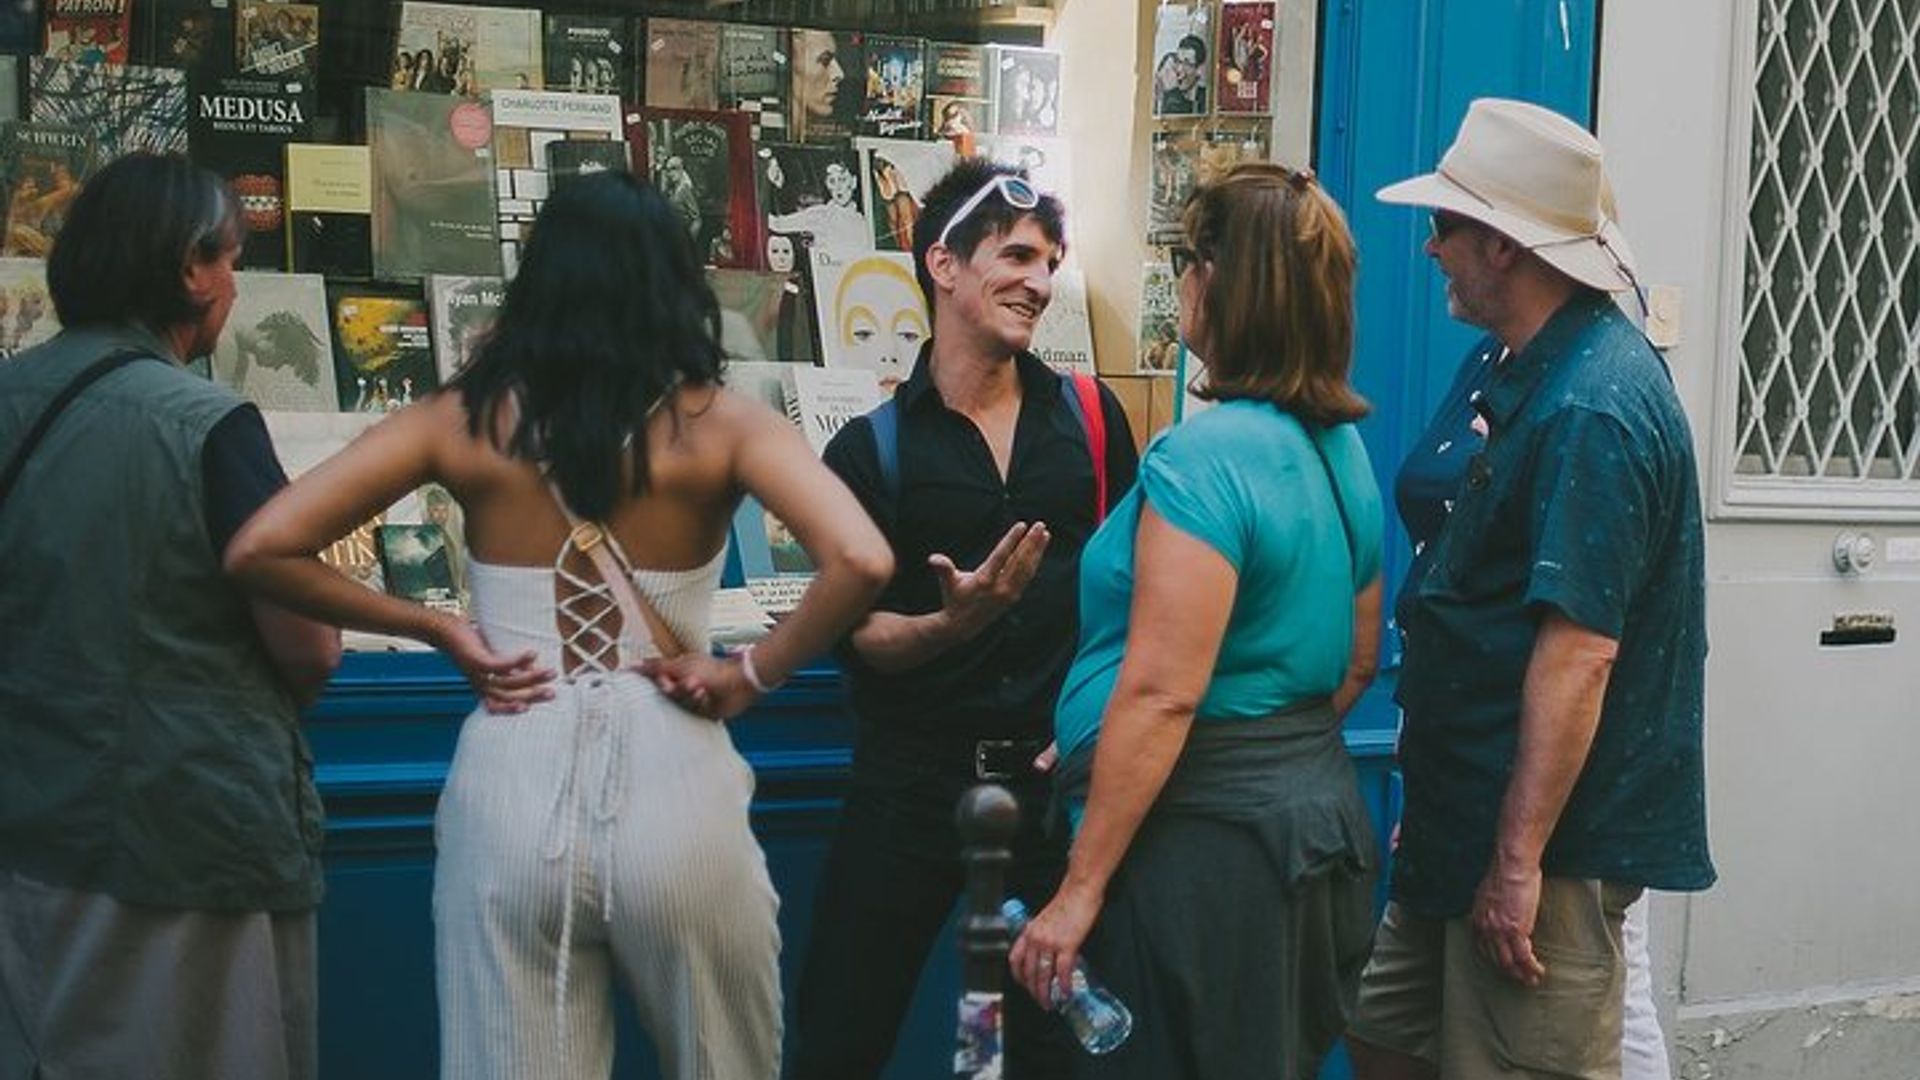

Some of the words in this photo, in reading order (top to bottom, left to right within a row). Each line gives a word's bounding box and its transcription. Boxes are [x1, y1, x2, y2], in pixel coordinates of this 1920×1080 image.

[199, 94, 304, 123] MEDUSA
[500, 98, 559, 111] CHARLOTTE
[562, 101, 612, 114] PERRIAND
